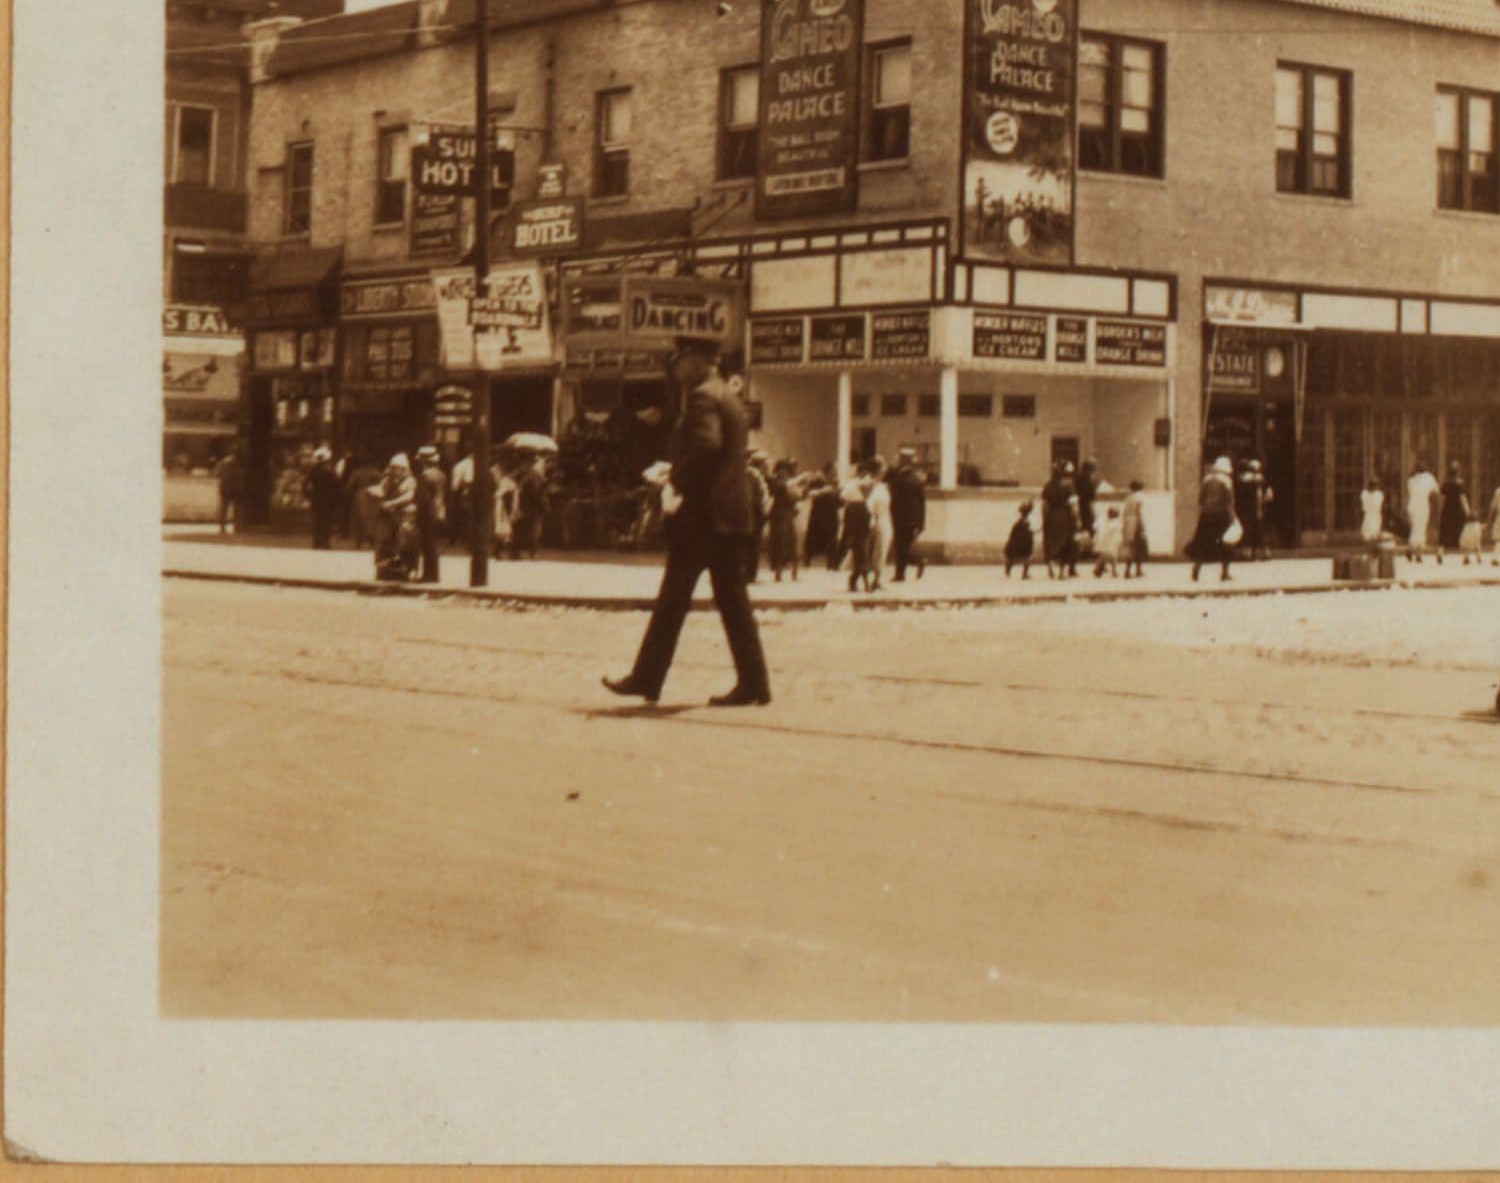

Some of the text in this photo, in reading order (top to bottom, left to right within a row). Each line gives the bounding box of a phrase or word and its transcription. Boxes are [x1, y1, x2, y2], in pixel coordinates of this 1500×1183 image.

[997, 40, 1048, 67] DANCE
[778, 64, 836, 93] DANCE
[990, 51, 1056, 92] PALACE
[768, 92, 846, 123] PALACE
[422, 161, 509, 188] HOTL
[515, 219, 579, 248] HOTEL
[633, 295, 726, 333] DANCING
